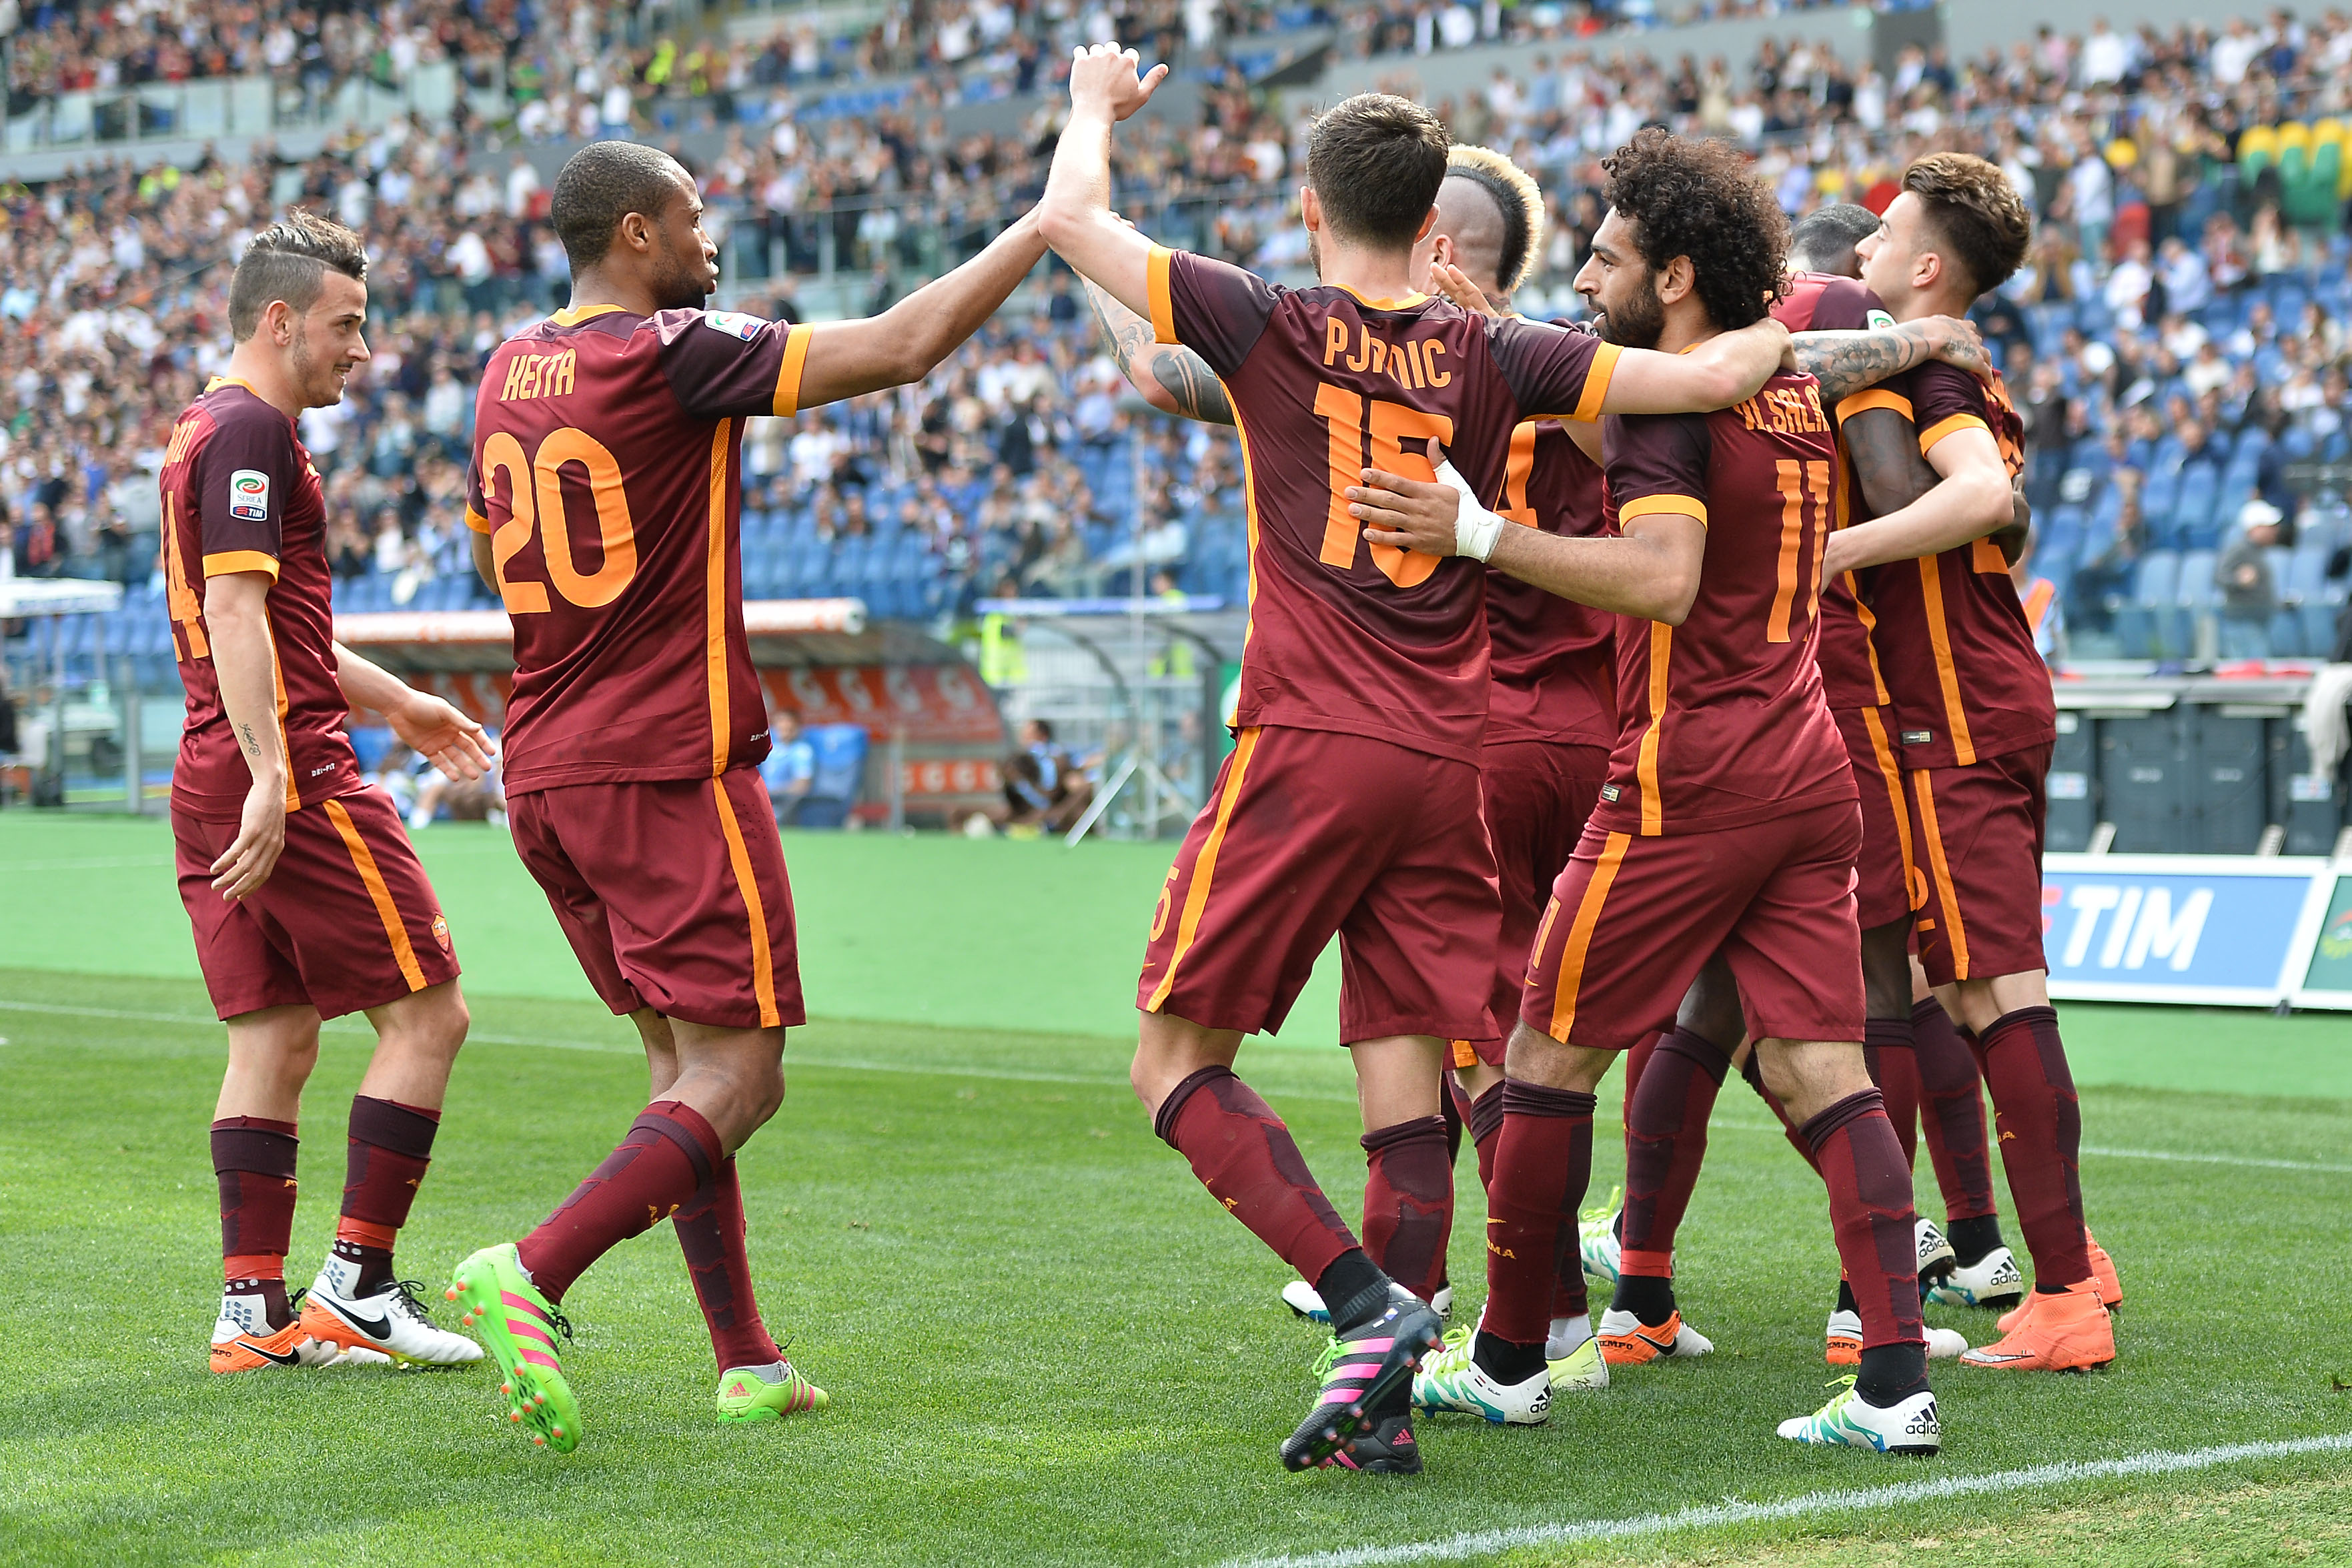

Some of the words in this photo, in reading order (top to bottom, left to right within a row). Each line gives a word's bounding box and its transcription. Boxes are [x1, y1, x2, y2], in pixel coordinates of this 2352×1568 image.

[500, 348, 576, 402] KEITA
[249, 508, 263, 518] TIM
[482, 427, 638, 615] 20
[1314, 381, 1453, 588] 15
[1767, 460, 1830, 643] 11
[2063, 885, 2214, 972] TIM
